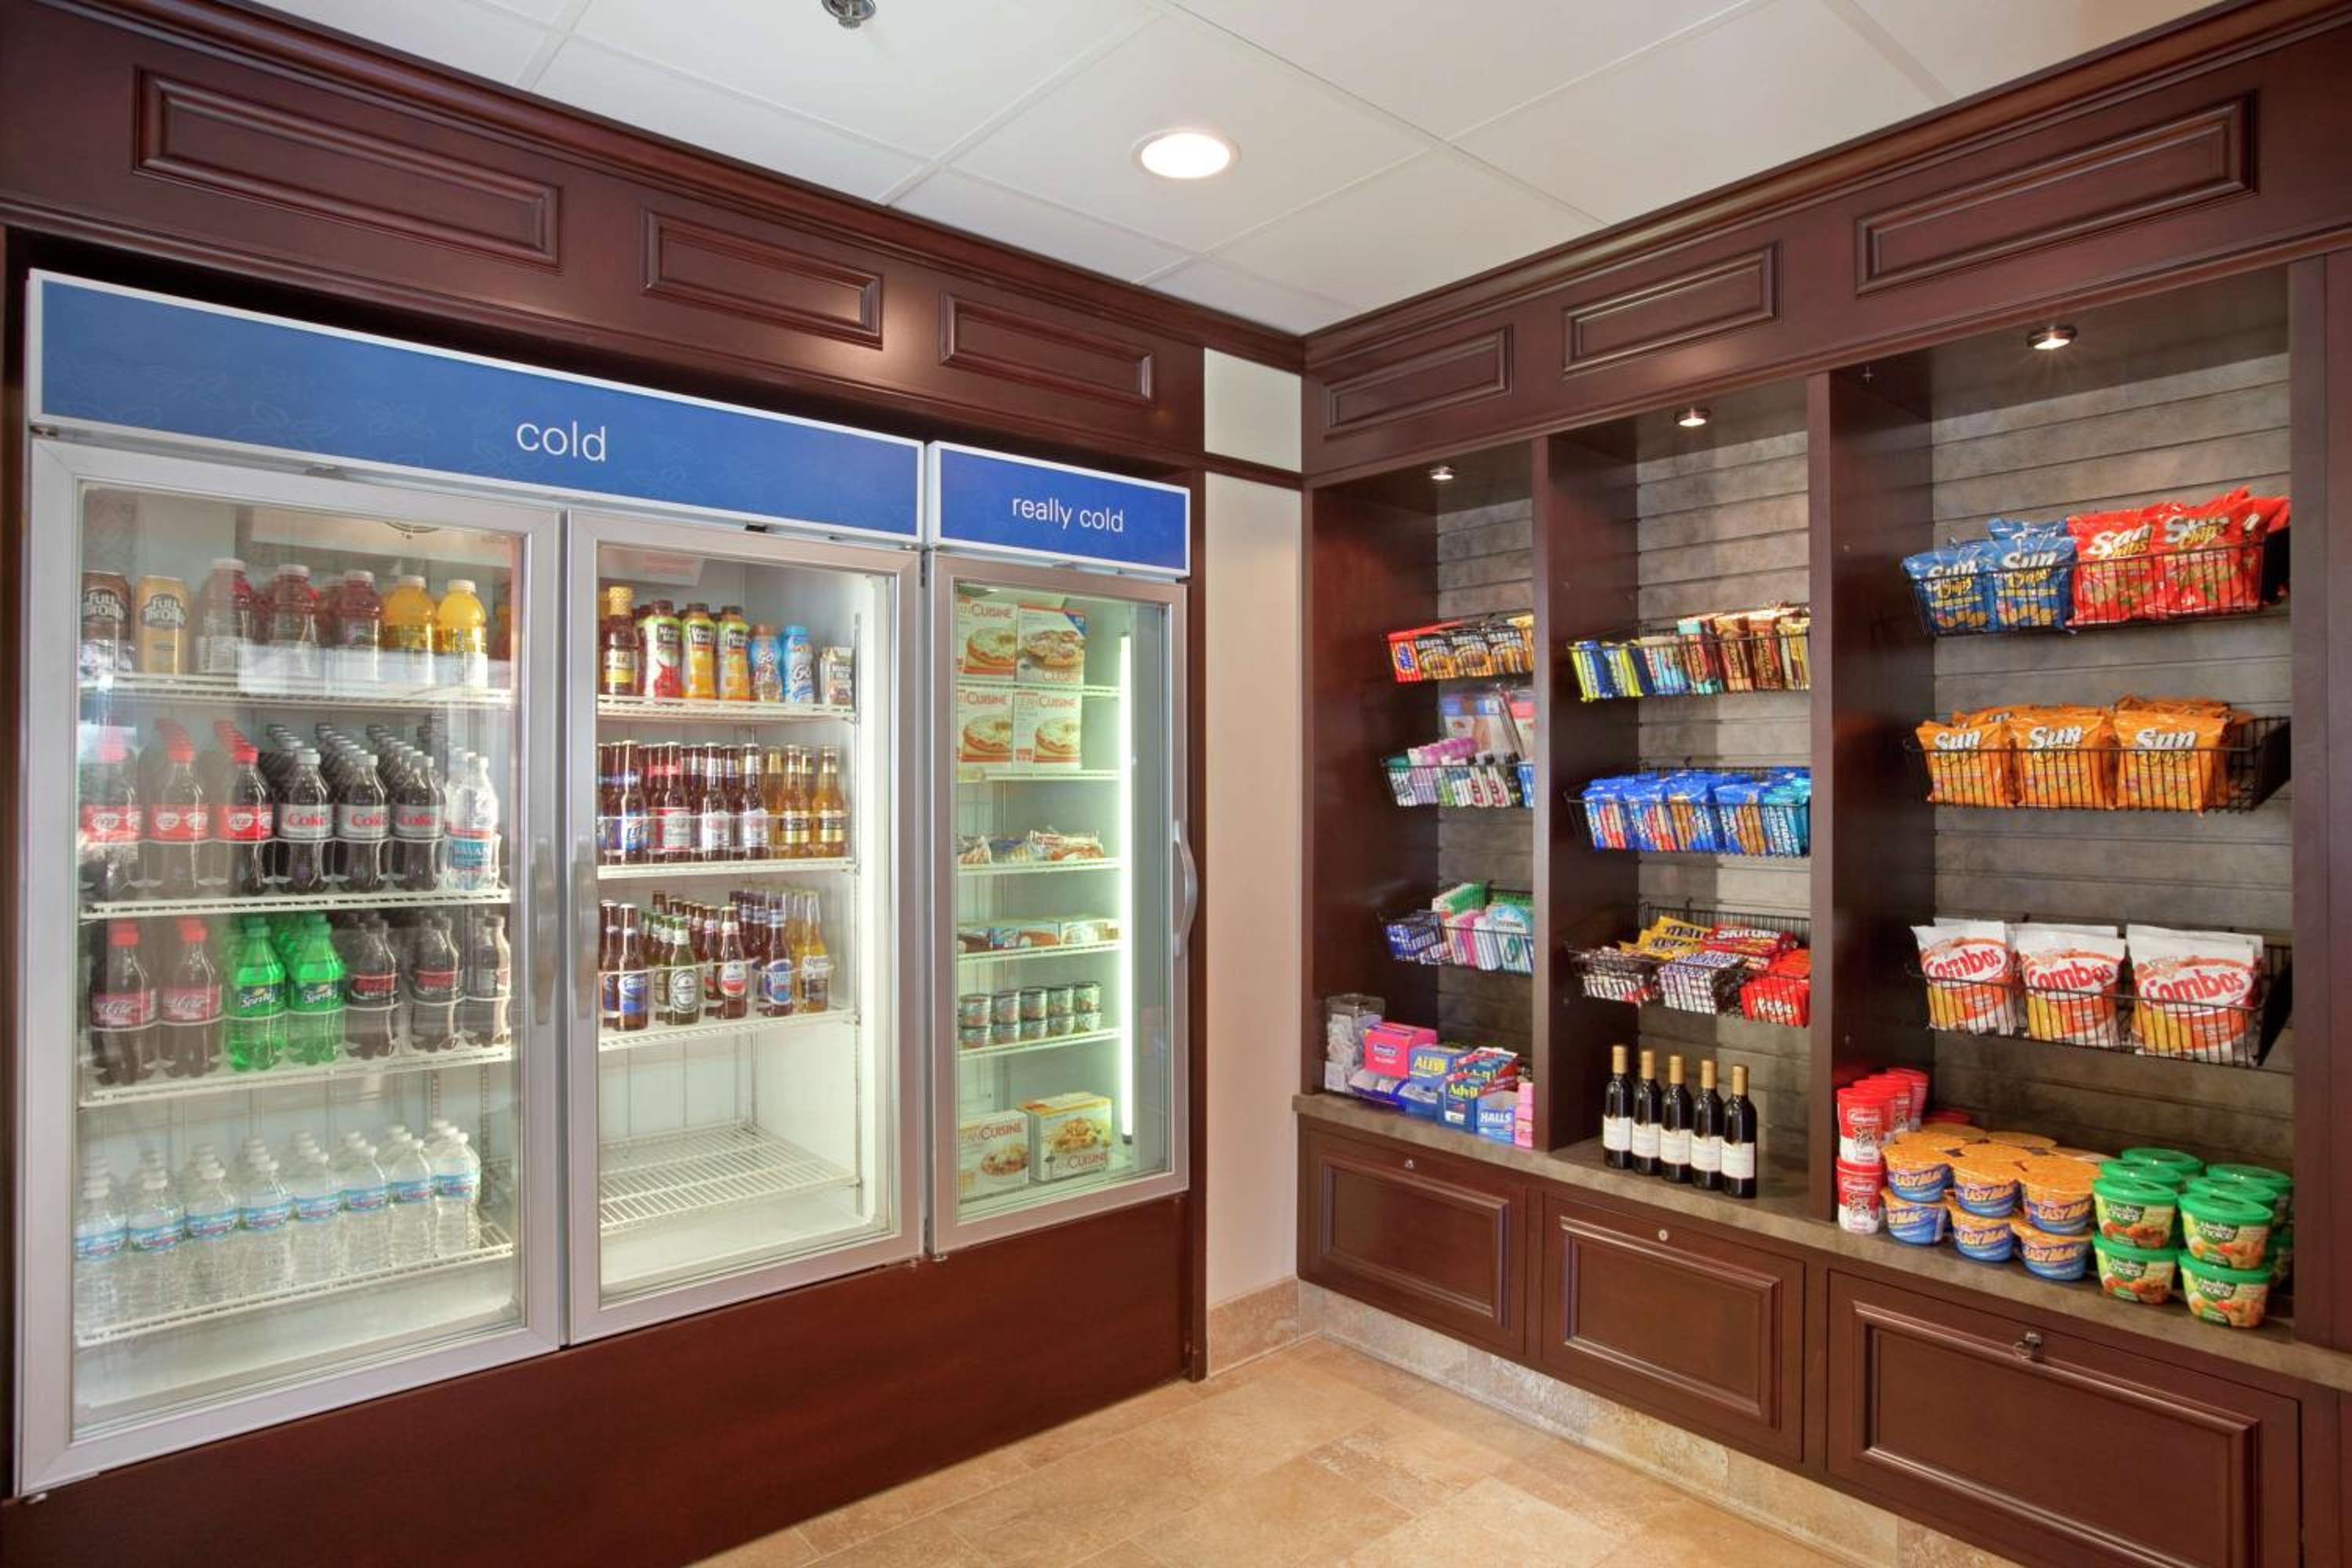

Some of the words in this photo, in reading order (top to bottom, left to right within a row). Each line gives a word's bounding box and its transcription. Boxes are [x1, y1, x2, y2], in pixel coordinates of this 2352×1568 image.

[516, 420, 606, 463] cold
[1011, 496, 1073, 531] really
[1079, 506, 1124, 533] cold
[2086, 523, 2153, 556] Sun
[1927, 559, 1978, 579] Sun
[2003, 551, 2057, 570] Sun
[1934, 731, 1982, 750] Sun
[2029, 726, 2084, 749] Sun
[2135, 728, 2197, 750] Sun
[1926, 948, 2002, 981] Combos
[2026, 960, 2114, 993] Combos
[2143, 968, 2245, 1008] Combos
[1479, 1111, 1512, 1124] HALLS
